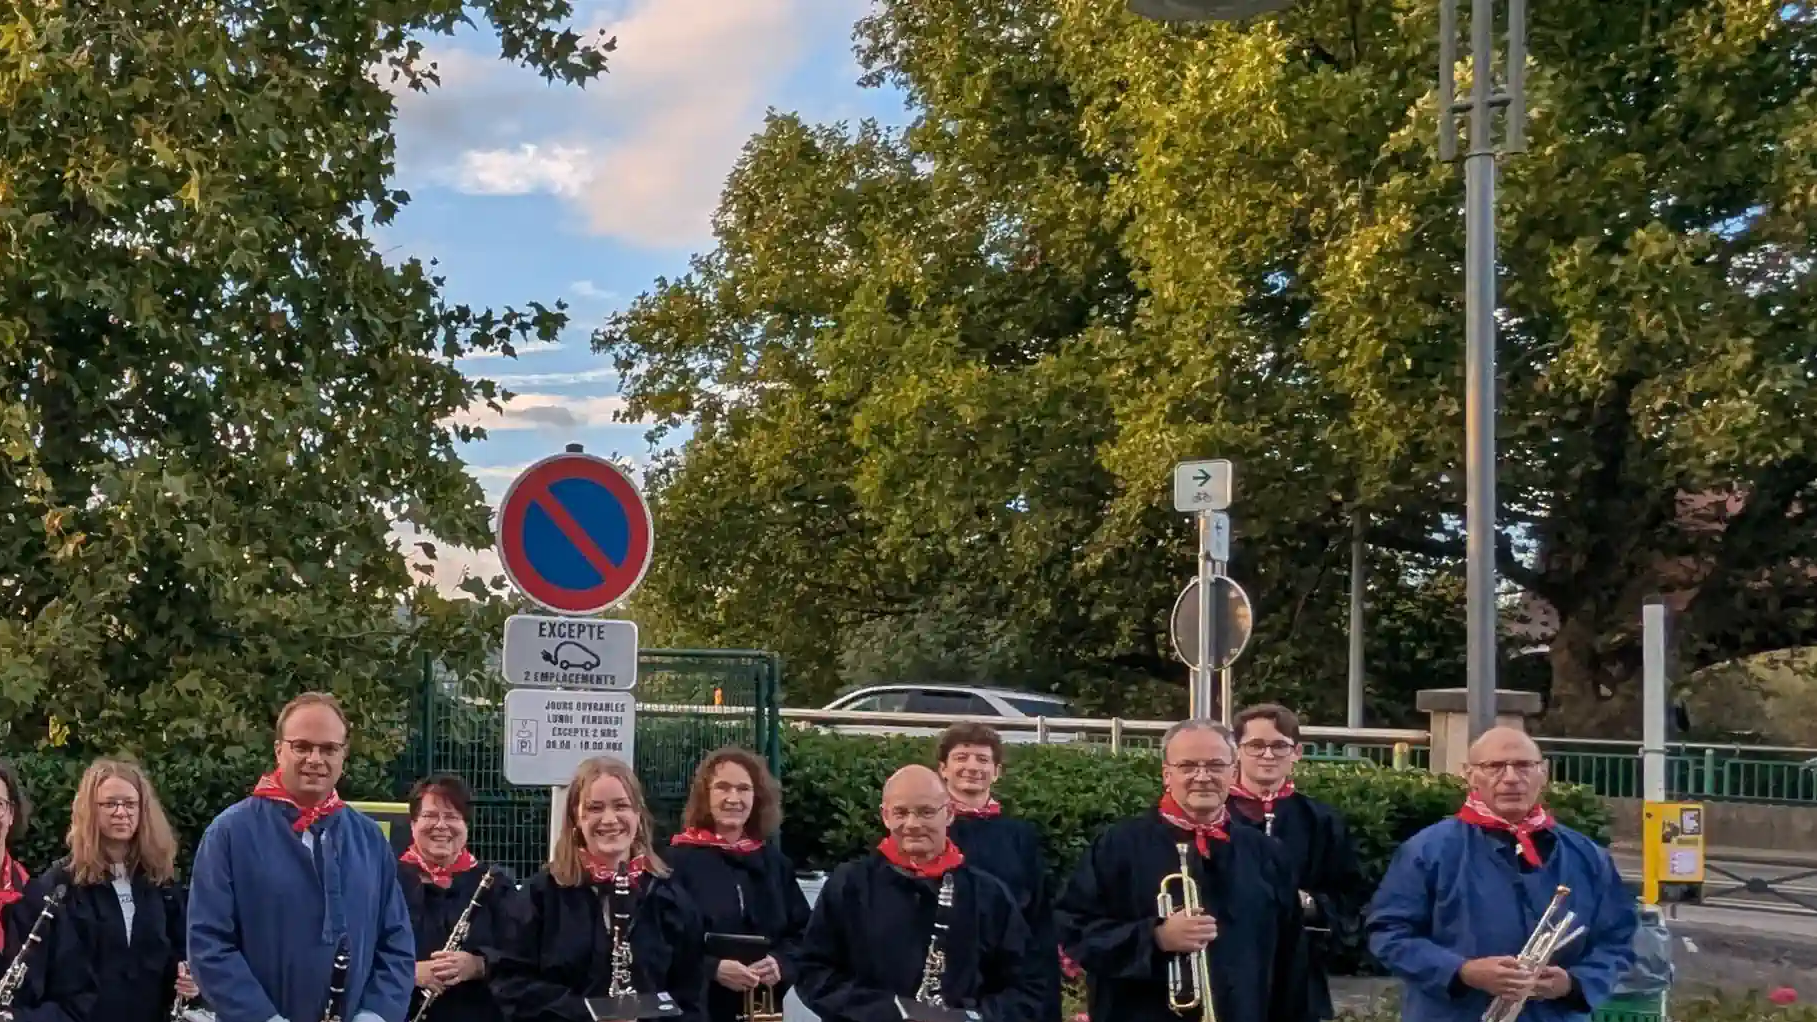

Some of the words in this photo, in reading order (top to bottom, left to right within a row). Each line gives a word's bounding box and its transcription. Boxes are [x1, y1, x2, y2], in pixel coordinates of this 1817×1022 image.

[538, 621, 606, 640] EXCEPTE
[523, 670, 531, 681] 2
[534, 672, 616, 685] EMPLACEMENTS
[545, 700, 573, 711] JOURS
